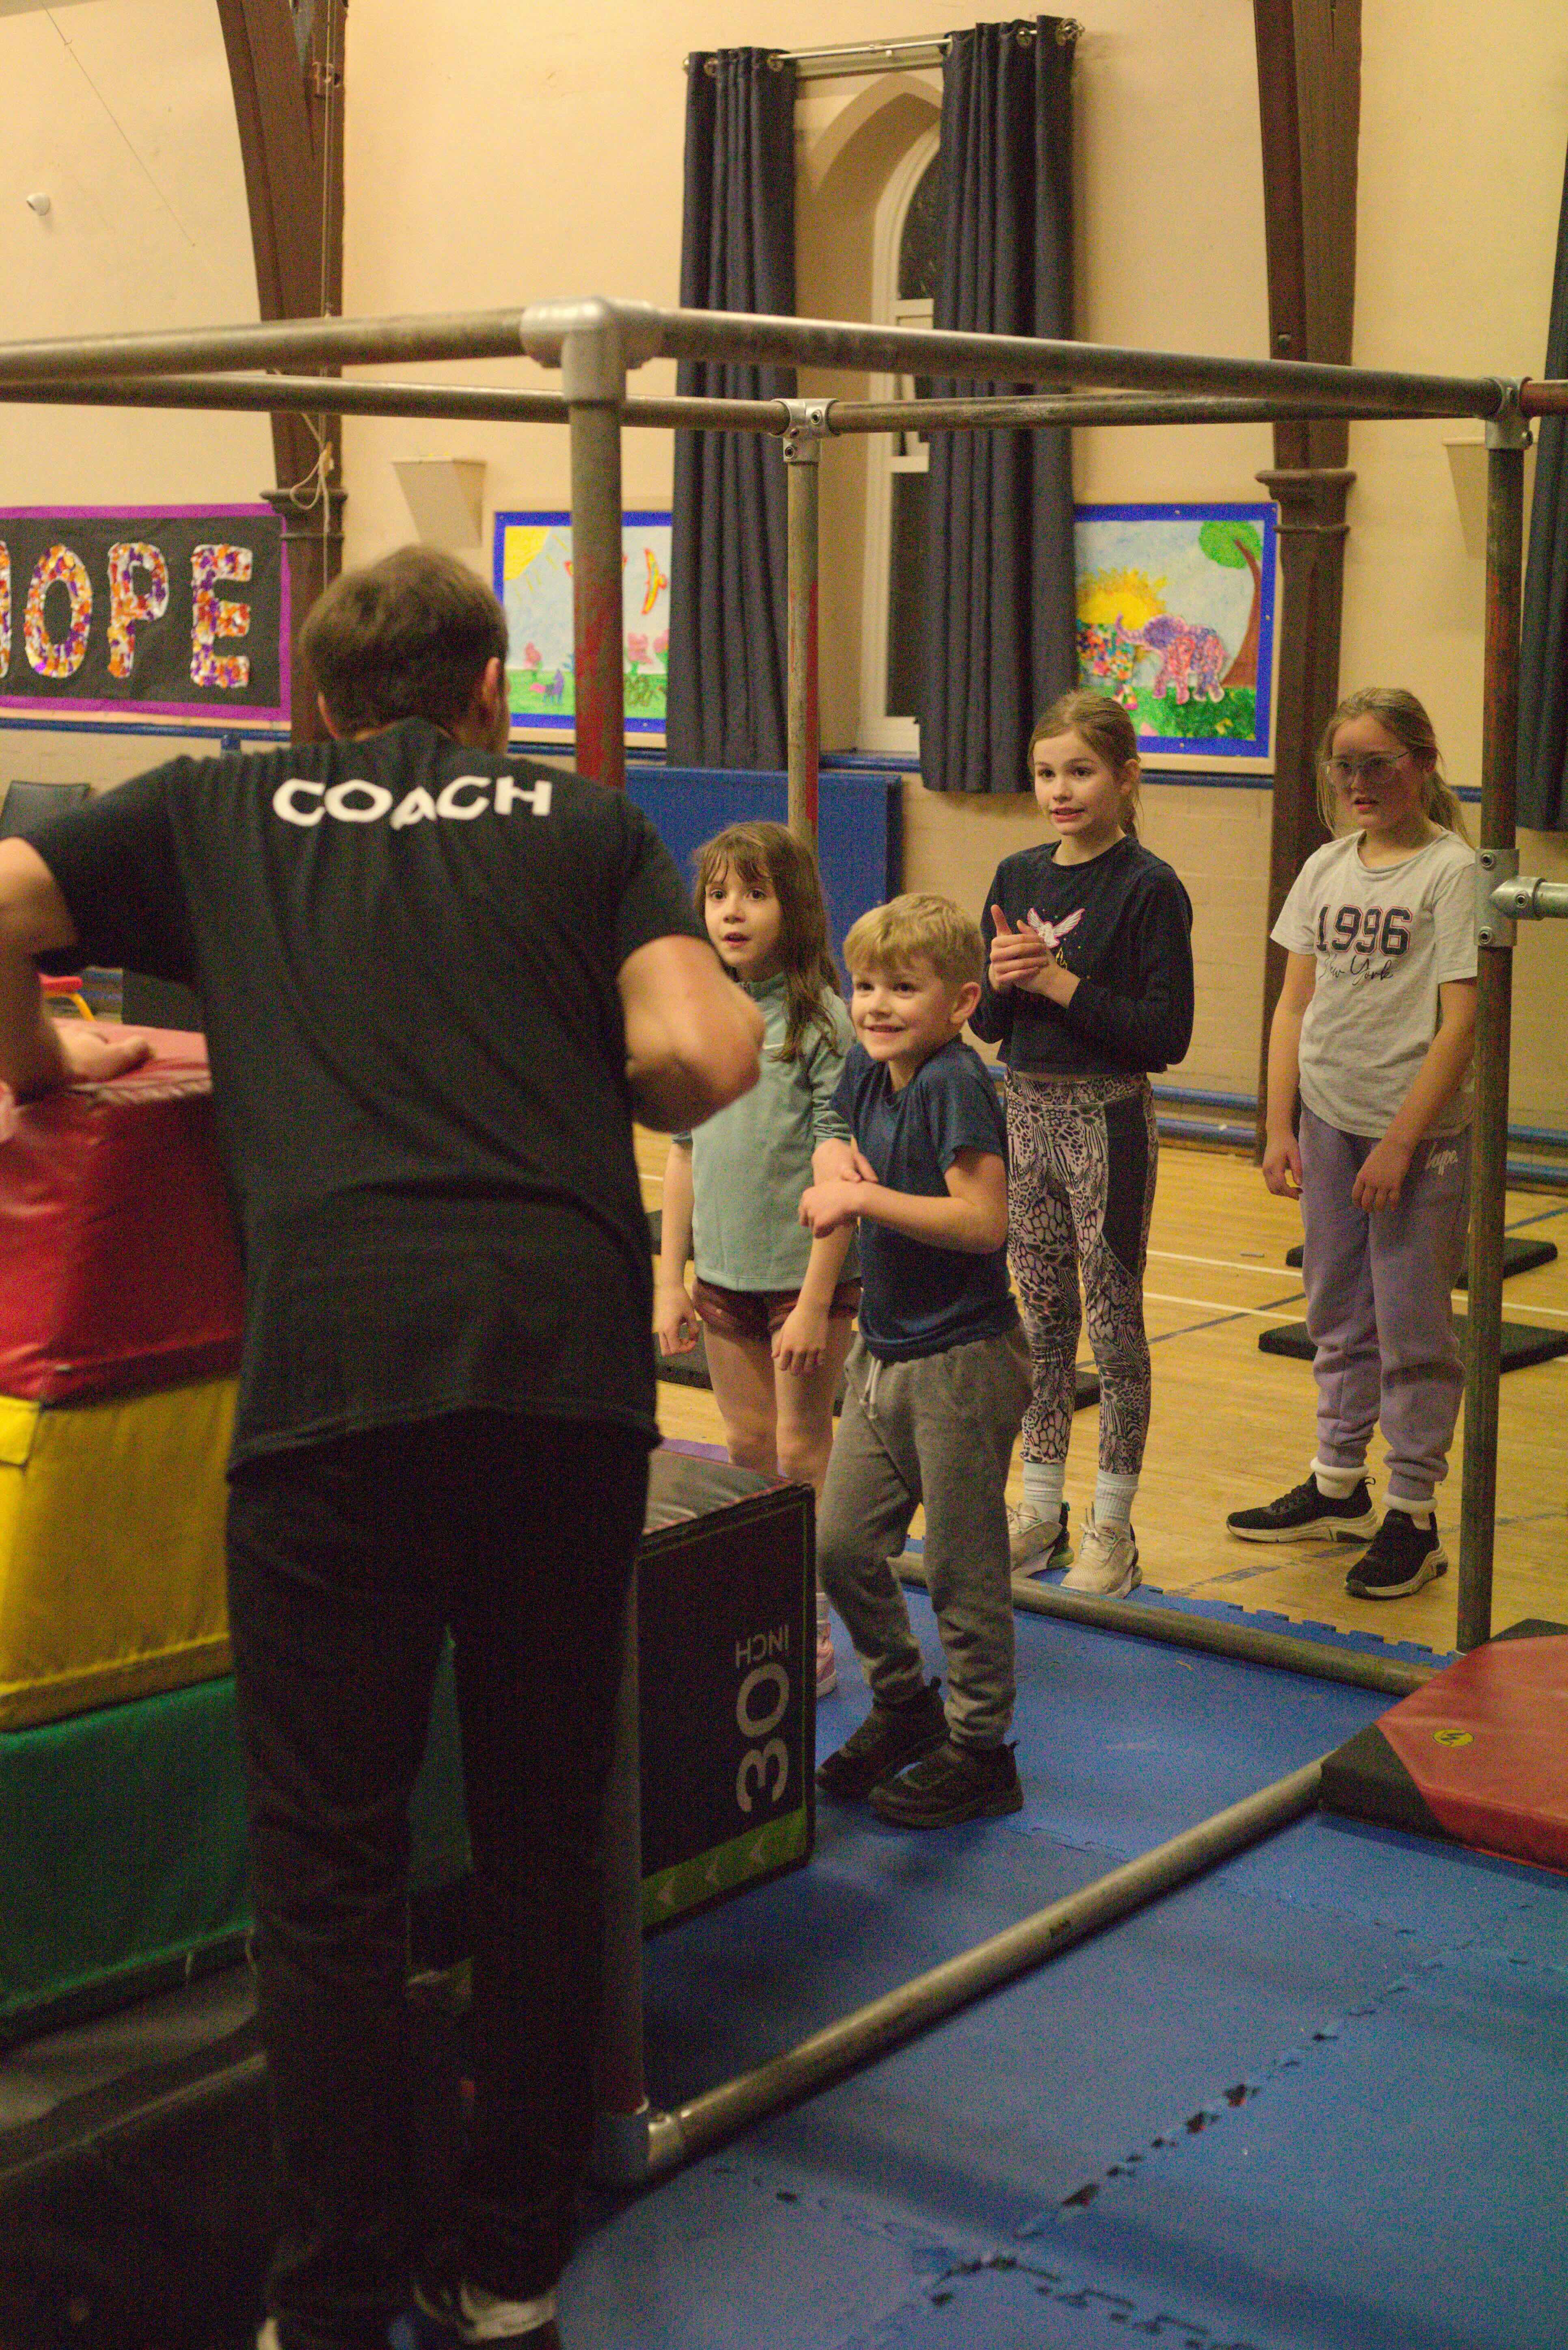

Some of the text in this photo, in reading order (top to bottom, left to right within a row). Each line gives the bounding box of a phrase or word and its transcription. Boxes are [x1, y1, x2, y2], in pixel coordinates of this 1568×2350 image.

[0, 540, 253, 688] OPE
[272, 775, 553, 830] COACH
[1315, 904, 1413, 957] 1996
[1350, 955, 1393, 986] York
[735, 1624, 789, 1668] INCH
[736, 1663, 789, 1812] 30
